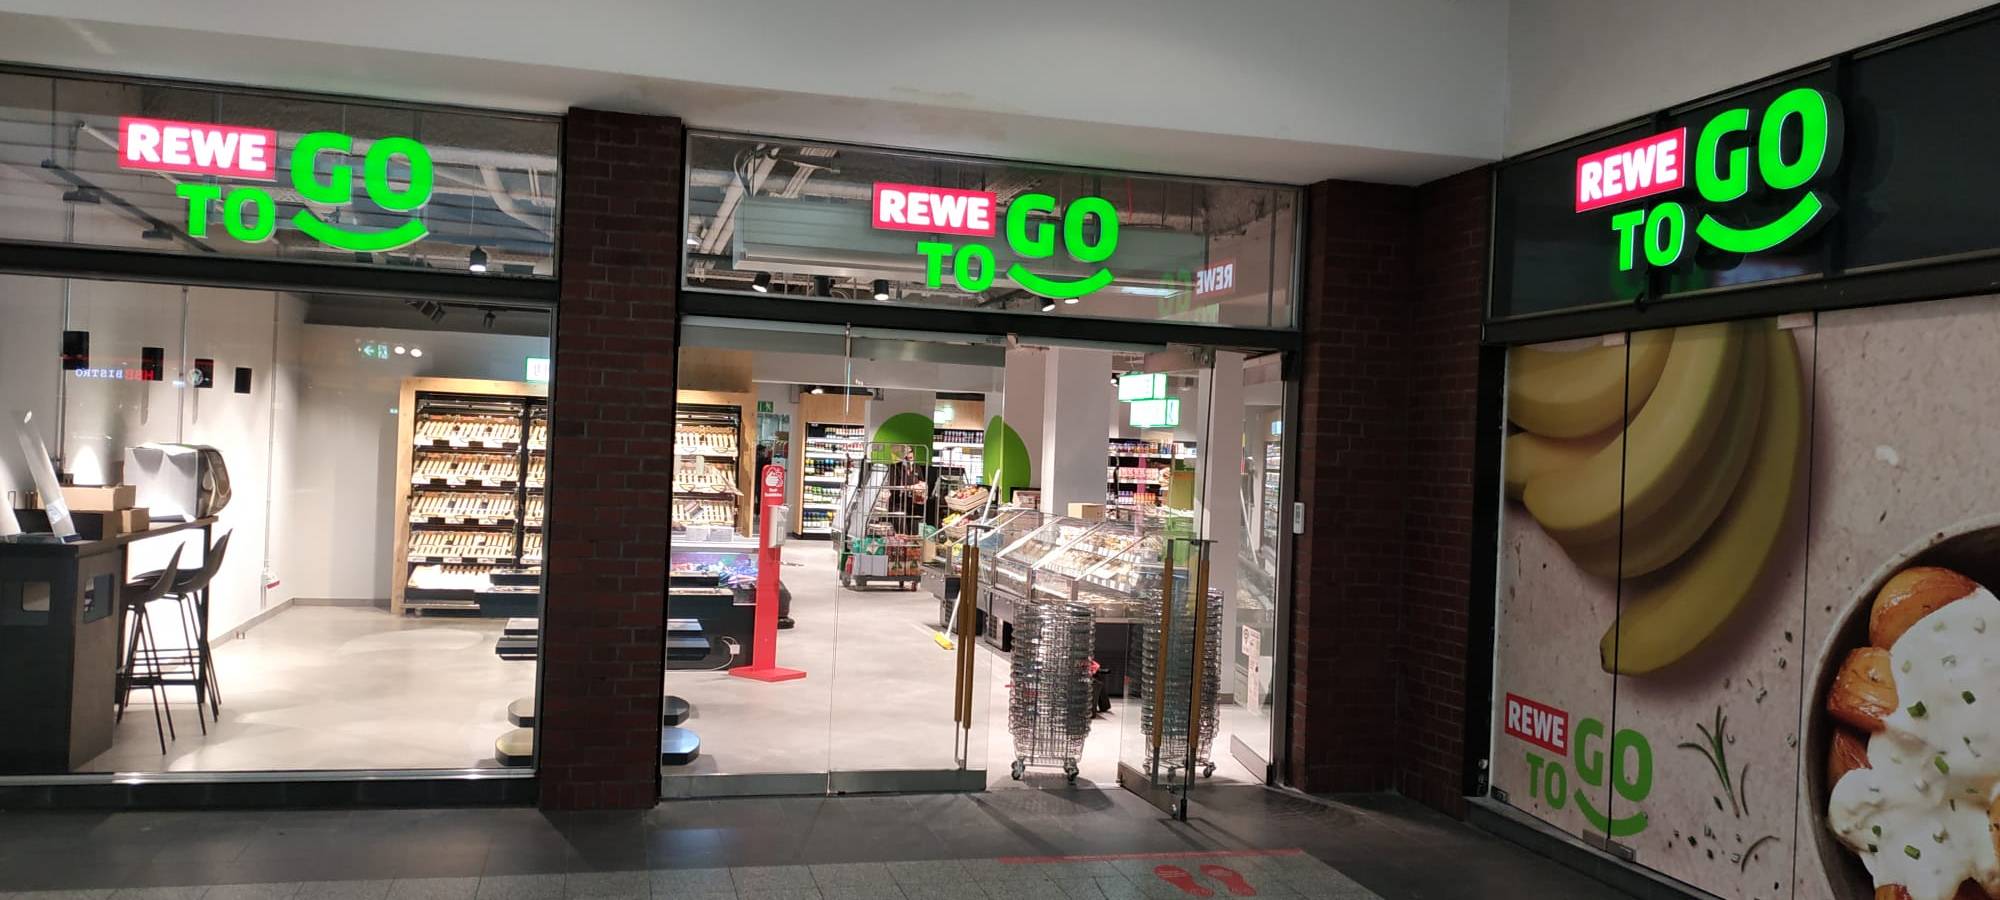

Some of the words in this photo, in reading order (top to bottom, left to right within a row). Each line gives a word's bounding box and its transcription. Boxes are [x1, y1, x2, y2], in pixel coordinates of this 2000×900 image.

[127, 122, 267, 172] REWE
[291, 131, 434, 211] GO
[1580, 139, 1678, 203] REWE
[1695, 88, 1828, 203] GO
[176, 184, 276, 243] TO
[880, 190, 990, 230] REWE
[1008, 193, 1119, 262] GO
[1612, 202, 1685, 271] TO
[918, 241, 996, 292] TO
[1508, 700, 1565, 748] REWE
[1526, 752, 1567, 809] TO
[1574, 718, 1653, 802] GO
